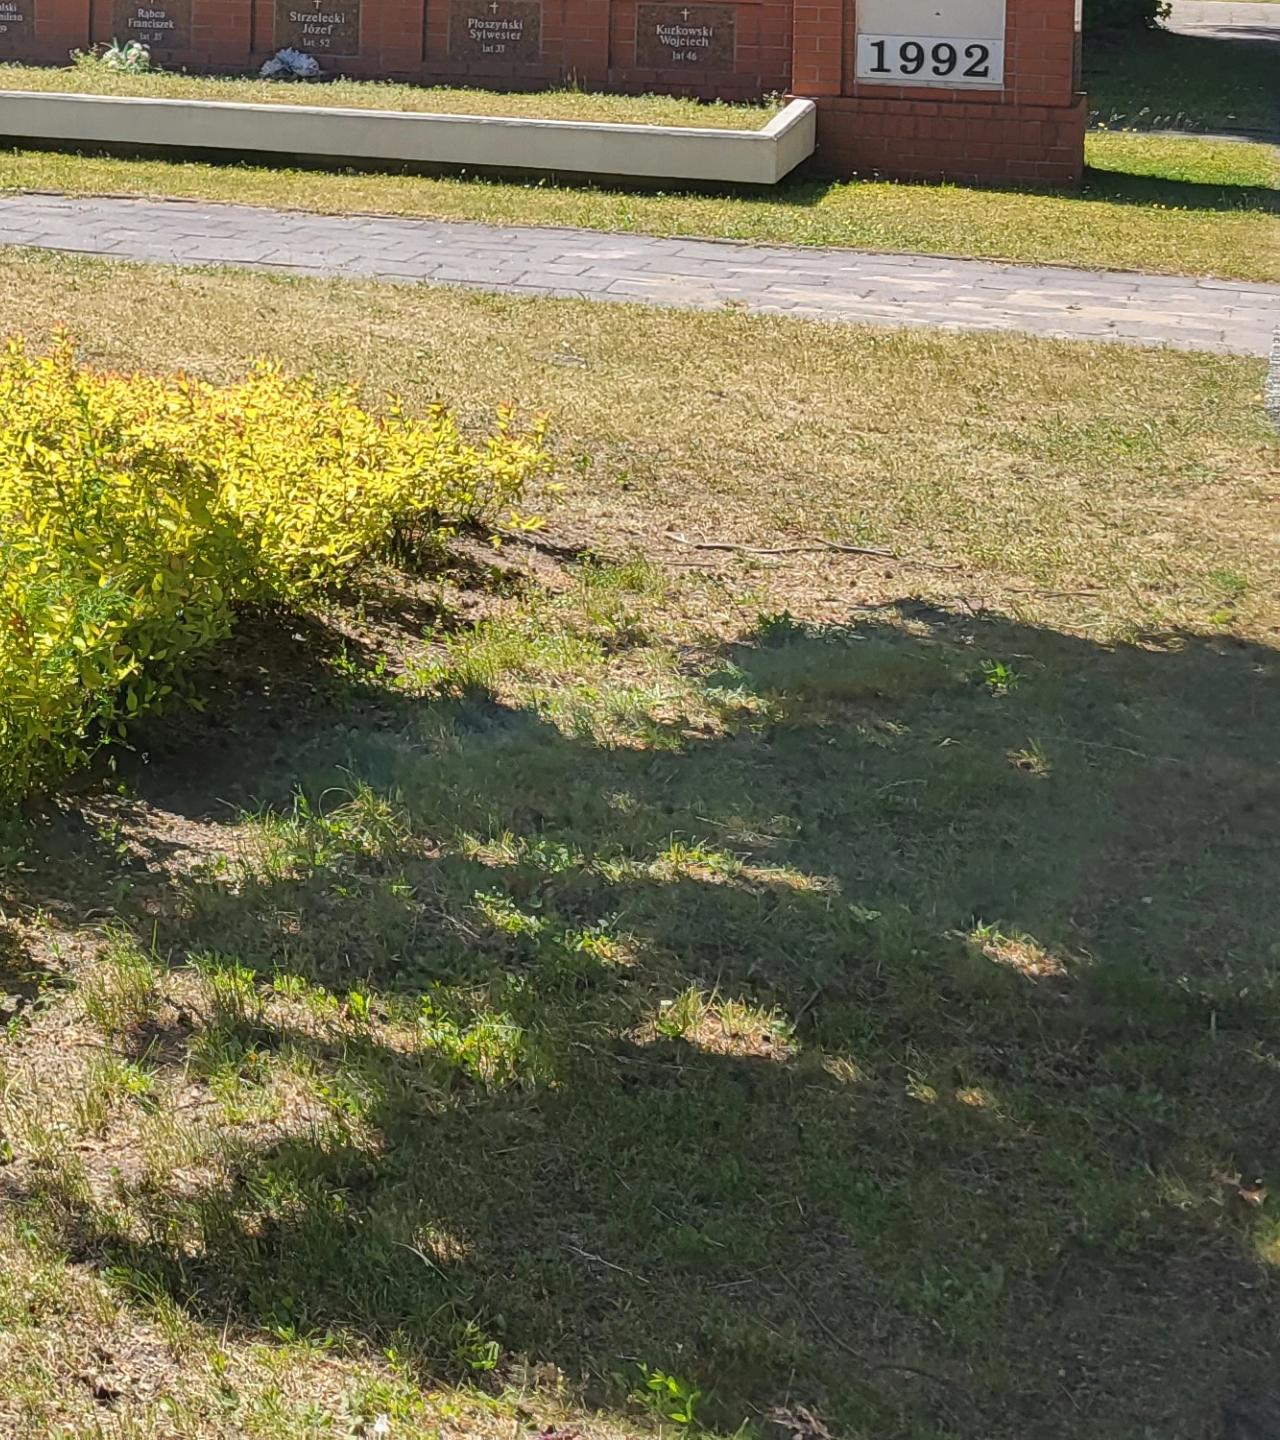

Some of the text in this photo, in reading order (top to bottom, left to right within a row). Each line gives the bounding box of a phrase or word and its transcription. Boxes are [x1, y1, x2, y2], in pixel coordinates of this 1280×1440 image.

[289, 11, 345, 23] Strzelecki
[128, 18, 175, 29] Franciszek
[302, 23, 334, 35] Józef
[469, 29, 522, 40] Sylwester
[656, 24, 713, 37] Kurkowski
[303, 38, 315, 47] lat
[660, 35, 709, 48] Wojciech
[482, 44, 493, 53] lat
[672, 50, 684, 61] lat
[868, 39, 990, 79] 1992
